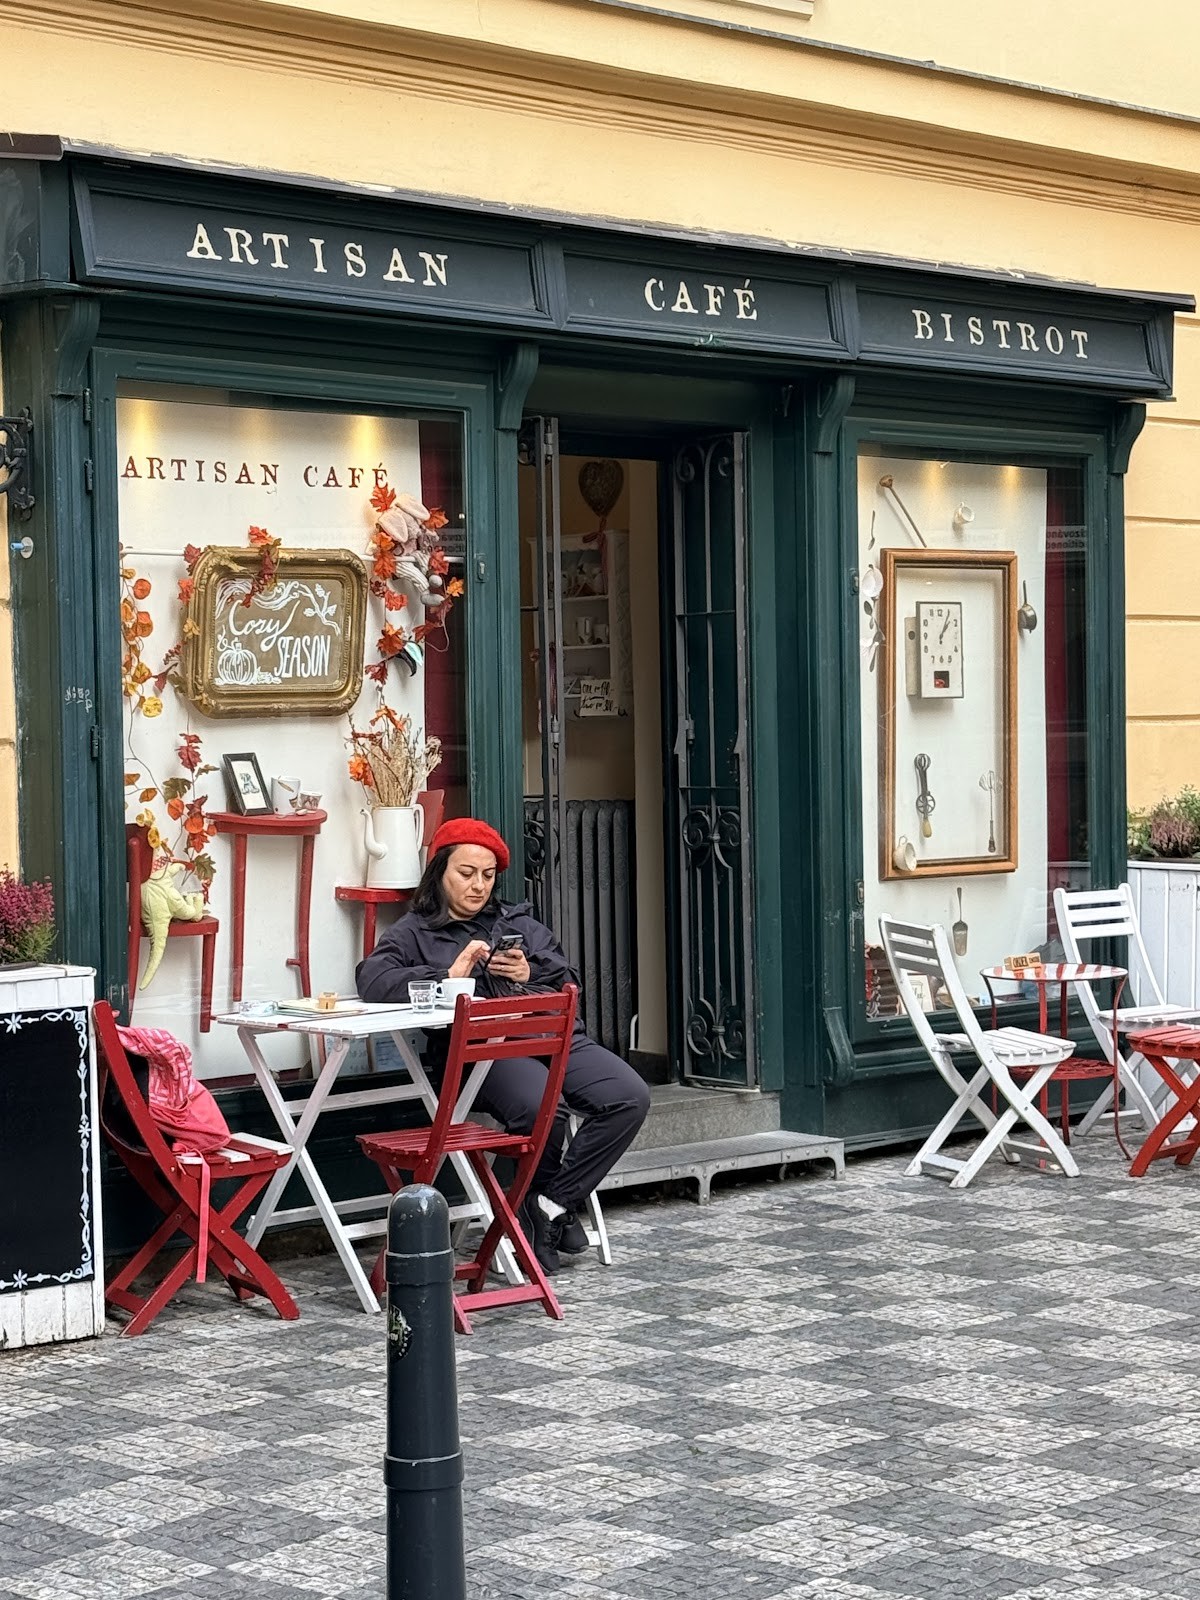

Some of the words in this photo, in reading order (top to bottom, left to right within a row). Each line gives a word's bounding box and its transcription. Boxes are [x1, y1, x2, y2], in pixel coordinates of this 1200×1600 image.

[186, 223, 449, 287] ARTISAN
[644, 277, 758, 321] CAFÉ
[911, 309, 1089, 360] BISTROT
[120, 455, 280, 486] ARTISAN
[303, 462, 390, 490] CAFÉ
[228, 599, 301, 653] Cozy
[273, 634, 331, 679] SEASON
